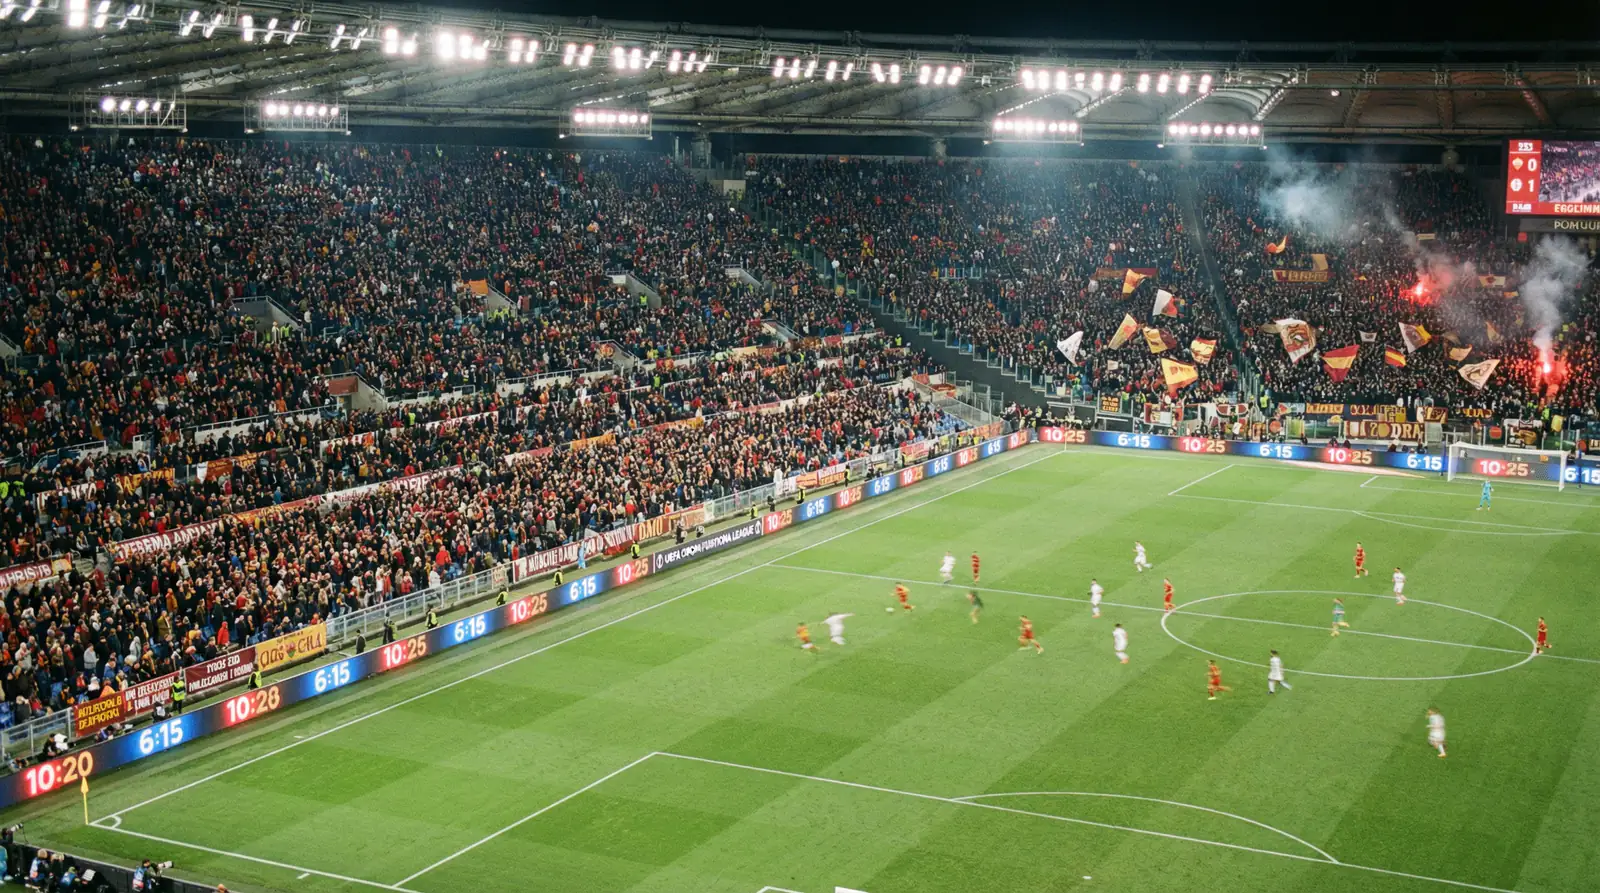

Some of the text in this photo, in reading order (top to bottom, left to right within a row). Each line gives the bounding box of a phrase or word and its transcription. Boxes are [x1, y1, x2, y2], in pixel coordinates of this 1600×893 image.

[1528, 158, 1537, 172] 0
[1528, 179, 1535, 193] 1
[1182, 439, 1226, 453] 10:25
[1259, 444, 1292, 458] 6:15
[1328, 449, 1372, 464] 10:25
[1407, 454, 1441, 470] 6:15
[616, 558, 649, 585] 10:25
[569, 575, 597, 600] 6:15
[511, 593, 548, 622] 10:25
[454, 615, 486, 642] 6:15
[383, 635, 427, 667] 10:25
[314, 662, 350, 693] 6:15
[227, 685, 281, 723] 10:28
[139, 719, 183, 755] 6:15
[27, 751, 93, 795] 10:20
